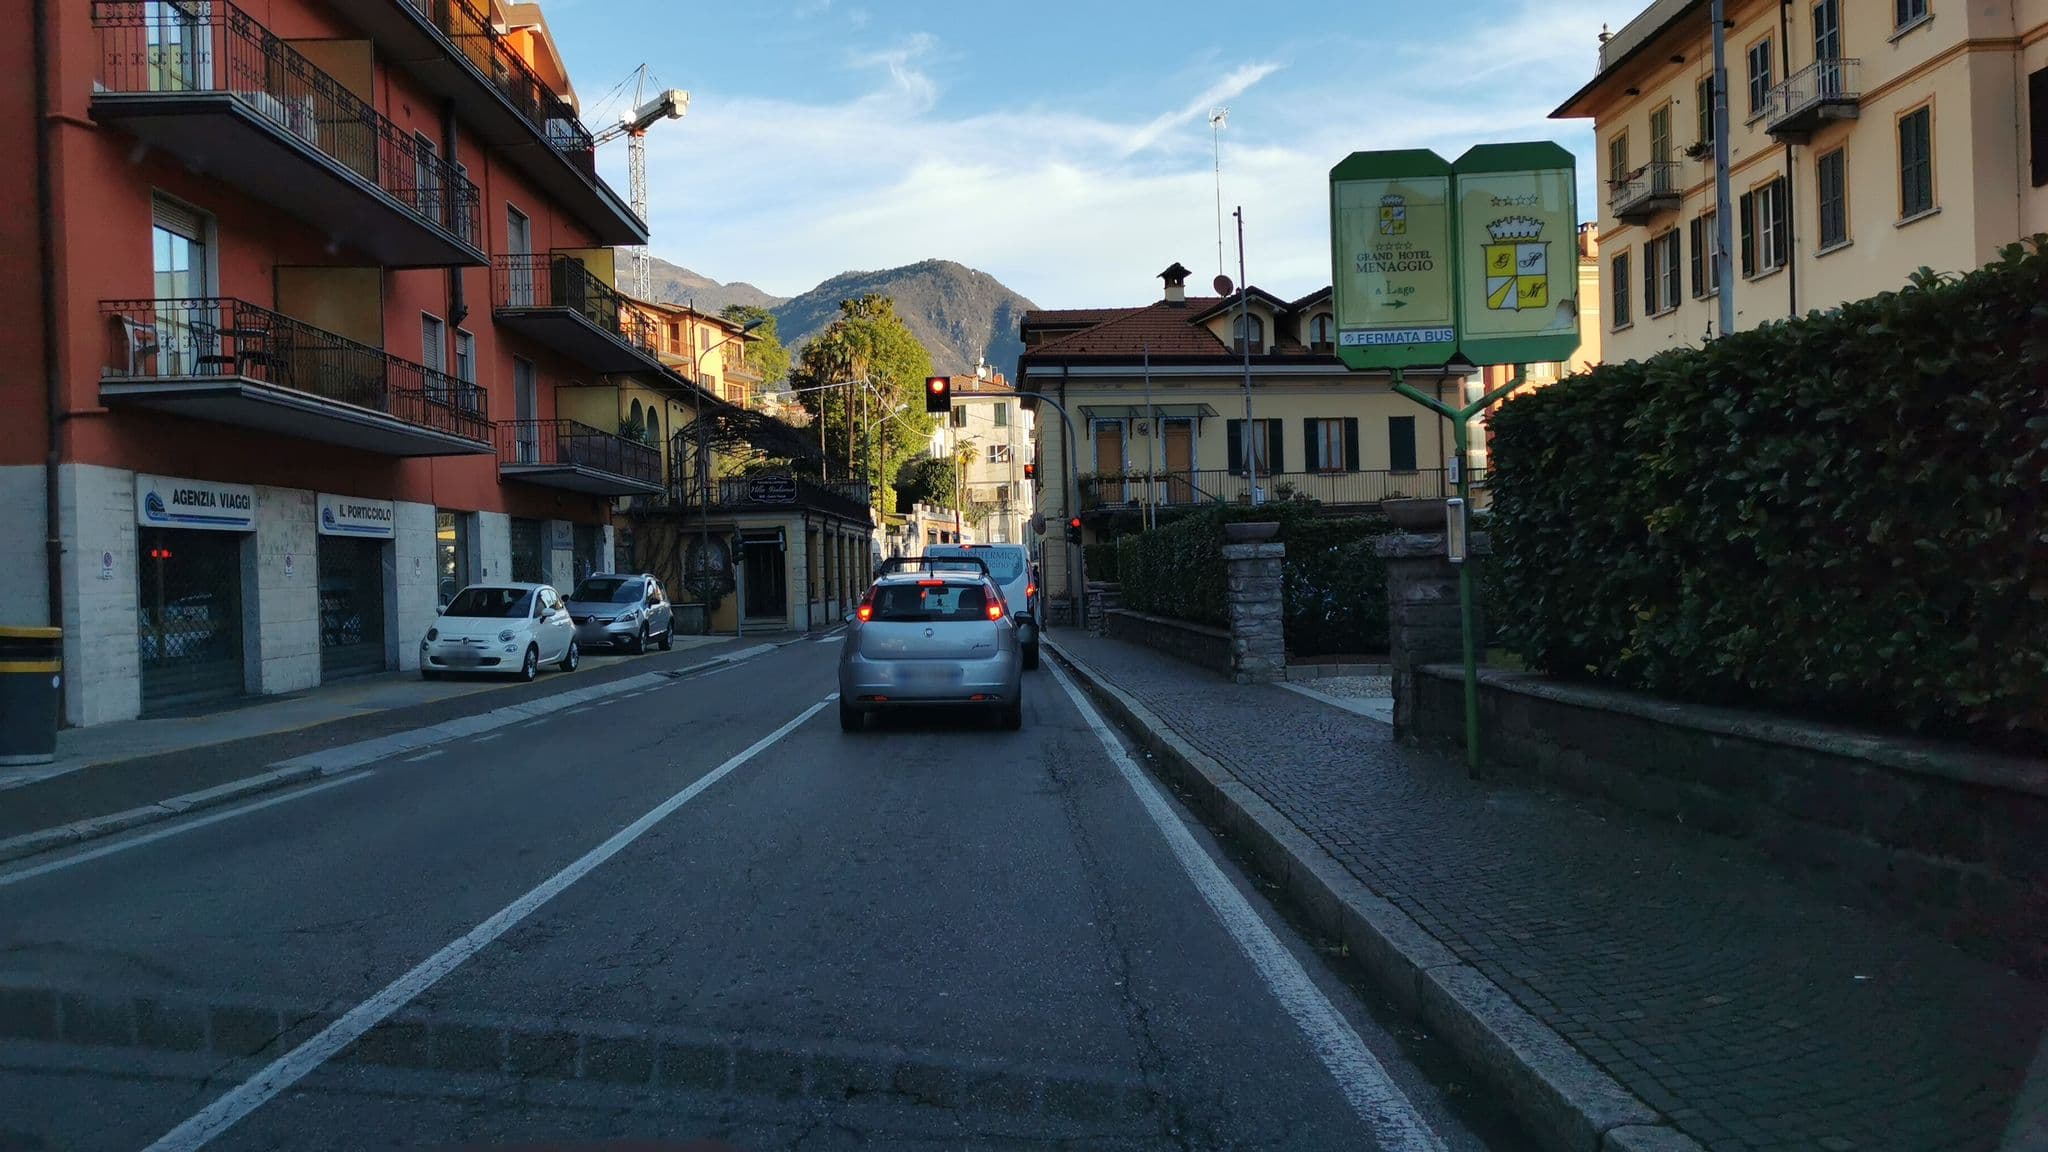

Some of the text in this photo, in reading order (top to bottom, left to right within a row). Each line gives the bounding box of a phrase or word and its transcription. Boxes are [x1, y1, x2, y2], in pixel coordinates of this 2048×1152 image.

[1357, 250, 1432, 261] GRAND HOTEL
[1356, 260, 1433, 273] MENAGGIO
[1386, 280, 1415, 296] Lago
[1357, 329, 1453, 344] FERMATA BUS
[172, 488, 251, 510] AGENZIA VIAGGI
[339, 503, 392, 521] IL PORTICCIOLO
